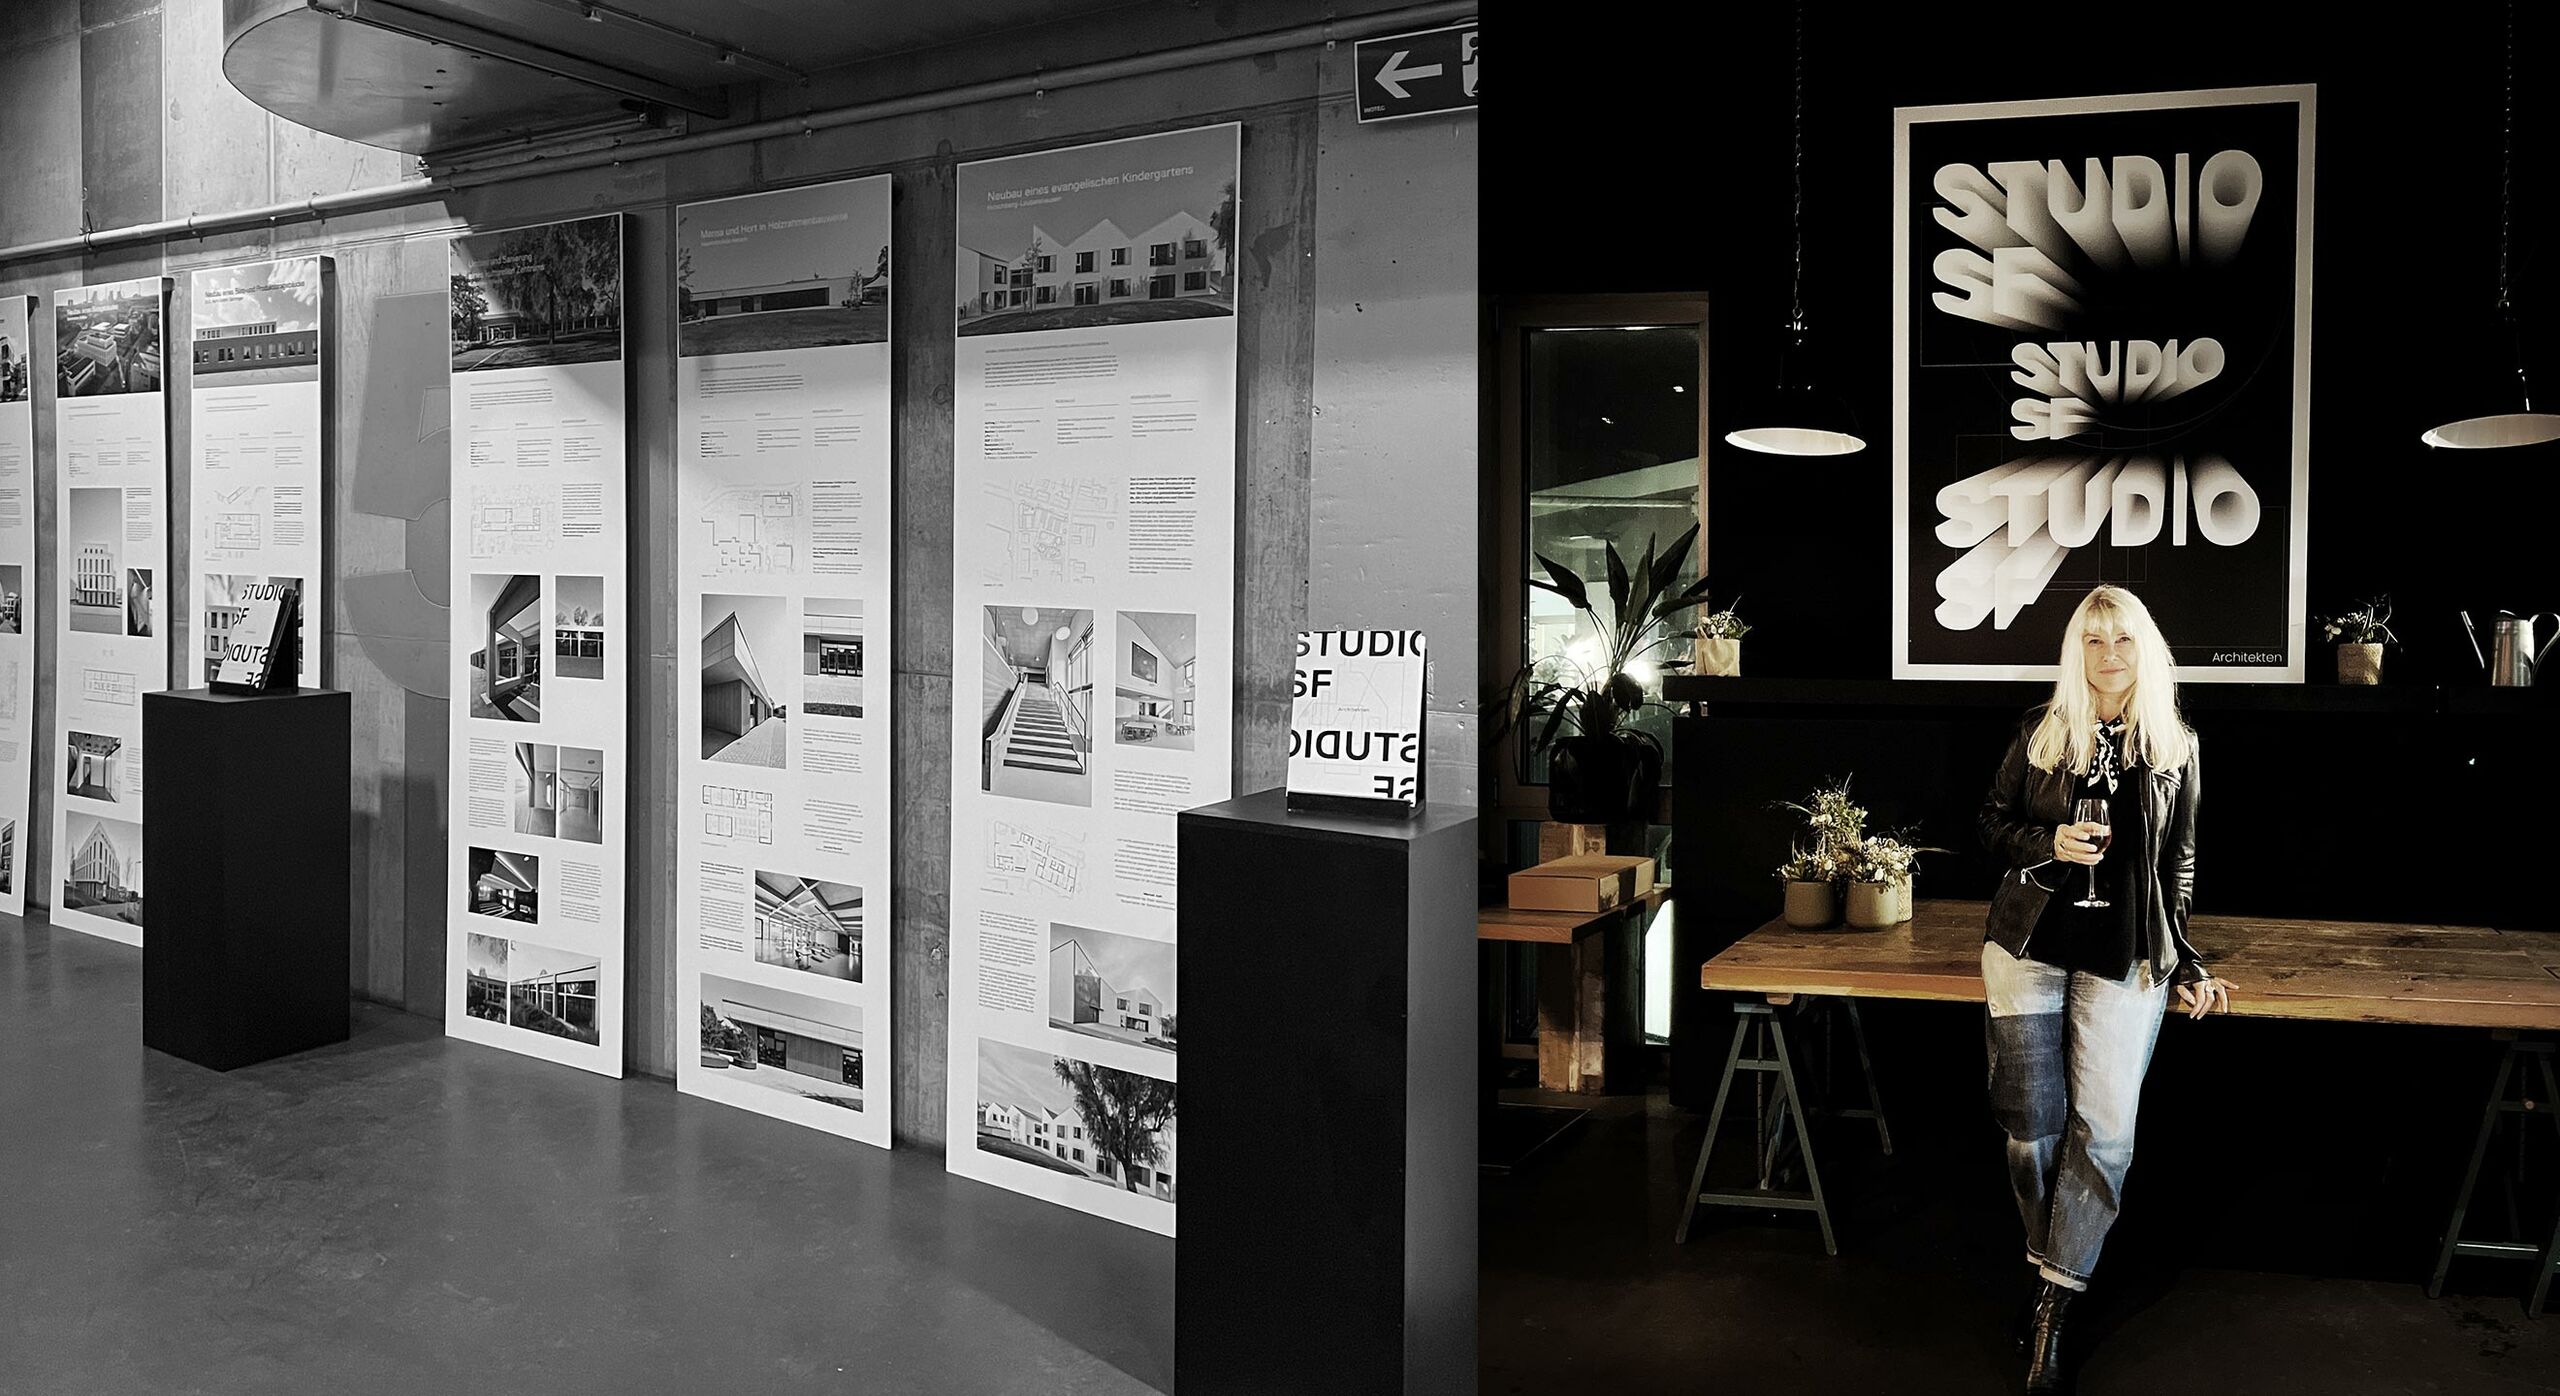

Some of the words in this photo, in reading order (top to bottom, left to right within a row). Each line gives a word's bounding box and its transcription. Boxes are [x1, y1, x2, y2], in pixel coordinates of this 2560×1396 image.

[987, 188, 1023, 202] Neubau
[1025, 186, 1049, 197] eines
[1051, 175, 1120, 194] evangelischen
[1122, 165, 1194, 184] Kindergartens
[1932, 149, 2263, 235] STUDIO
[725, 224, 740, 236] und
[1932, 246, 2062, 324] SF
[2010, 337, 2225, 393] STUDIO
[2010, 397, 2094, 441] SF
[1935, 474, 2262, 548] STUDIO
[1934, 554, 2044, 631] SF
[2212, 651, 2283, 664] Architekten
